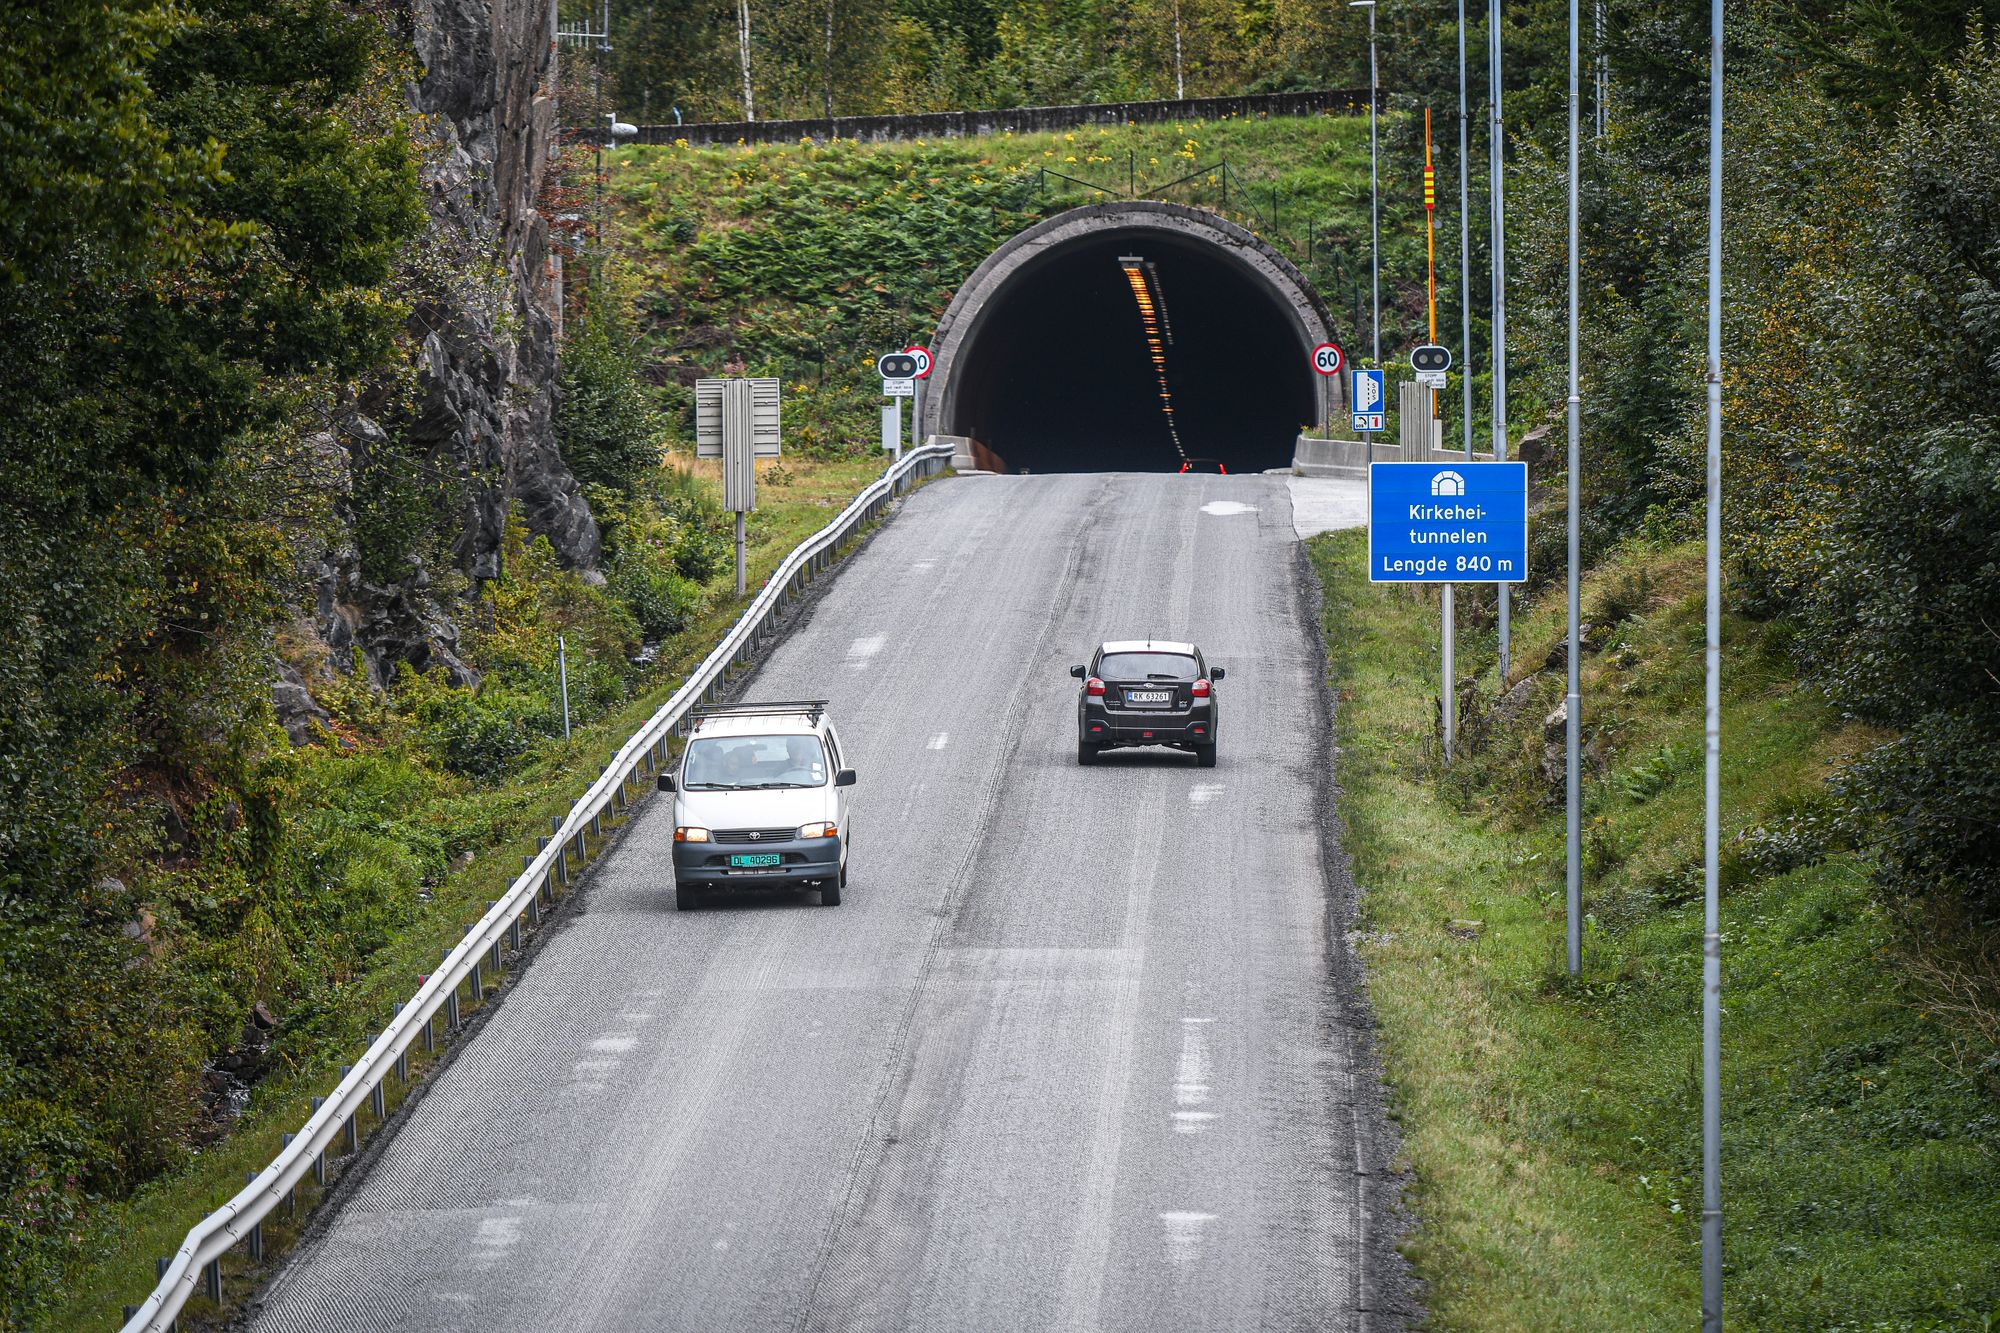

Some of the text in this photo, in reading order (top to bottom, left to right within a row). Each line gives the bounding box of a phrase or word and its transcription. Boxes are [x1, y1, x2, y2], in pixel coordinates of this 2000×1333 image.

[916, 354, 927, 370] 0
[1317, 351, 1338, 368] 60
[1409, 504, 1486, 520] Kirkehei-
[1409, 528, 1487, 544] tunnelen
[1383, 556, 1513, 575] Lengde 840 m
[1133, 692, 1143, 700] RK
[733, 856, 745, 864] DL
